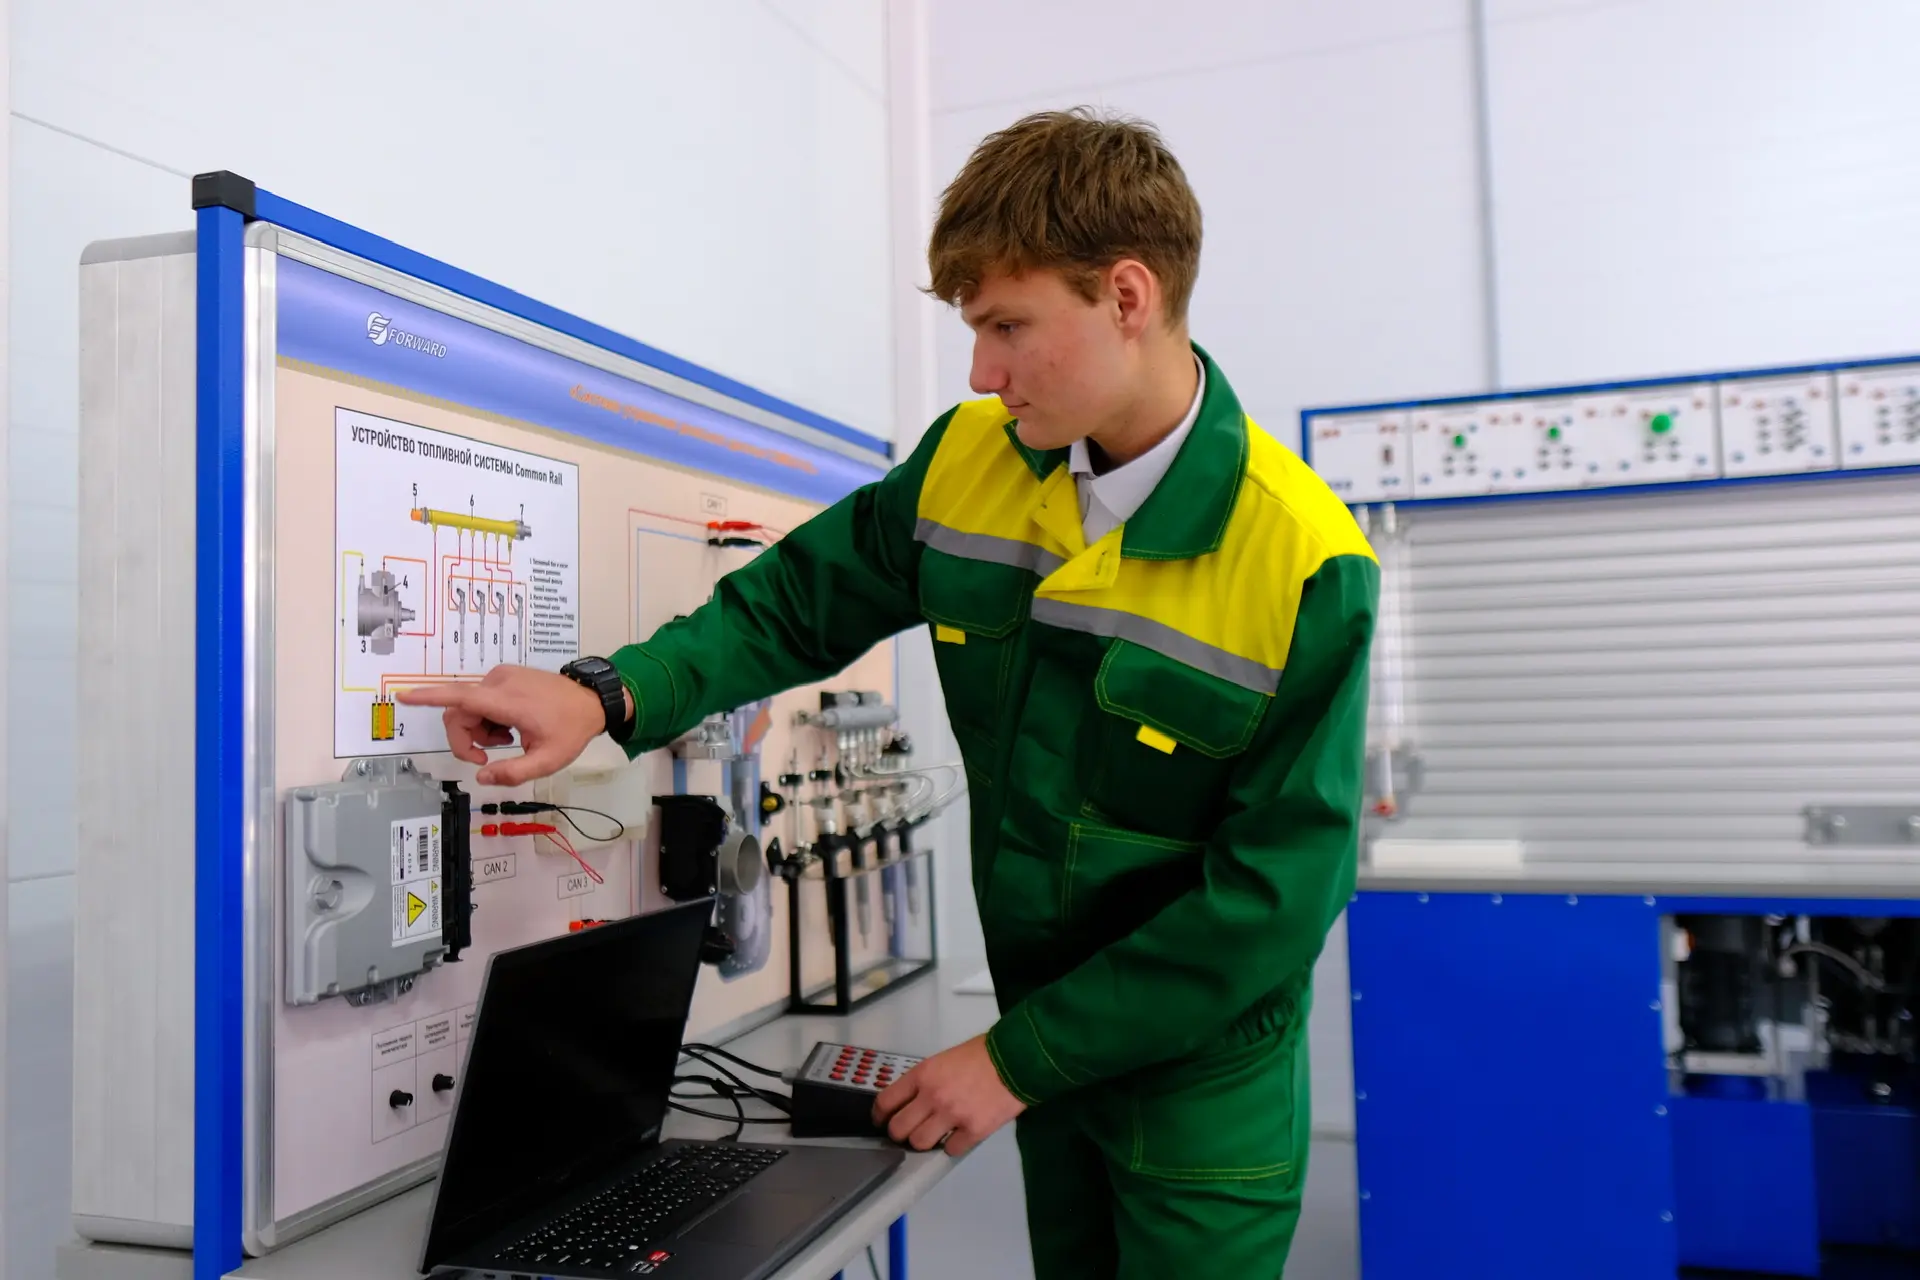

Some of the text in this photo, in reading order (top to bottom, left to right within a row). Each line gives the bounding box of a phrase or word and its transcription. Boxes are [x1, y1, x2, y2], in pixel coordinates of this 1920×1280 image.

[387, 328, 448, 359] FORWARD
[351, 425, 563, 486] УСТРОЙСТВО ТОПЛИВНОЙ СИСТЕМЫ Common Rail
[412, 483, 418, 496] 5
[469, 495, 475, 507] 6
[519, 504, 525, 516] 7
[402, 575, 409, 589] 4
[453, 631, 459, 643] 8
[474, 631, 479, 644] 8
[493, 632, 498, 645] 8
[512, 634, 517, 646] 8
[361, 640, 367, 653] 3
[399, 723, 405, 736] 2
[483, 860, 508, 876] CAN 2
[567, 876, 588, 892] CAN 3
[431, 895, 439, 928] WARNING
